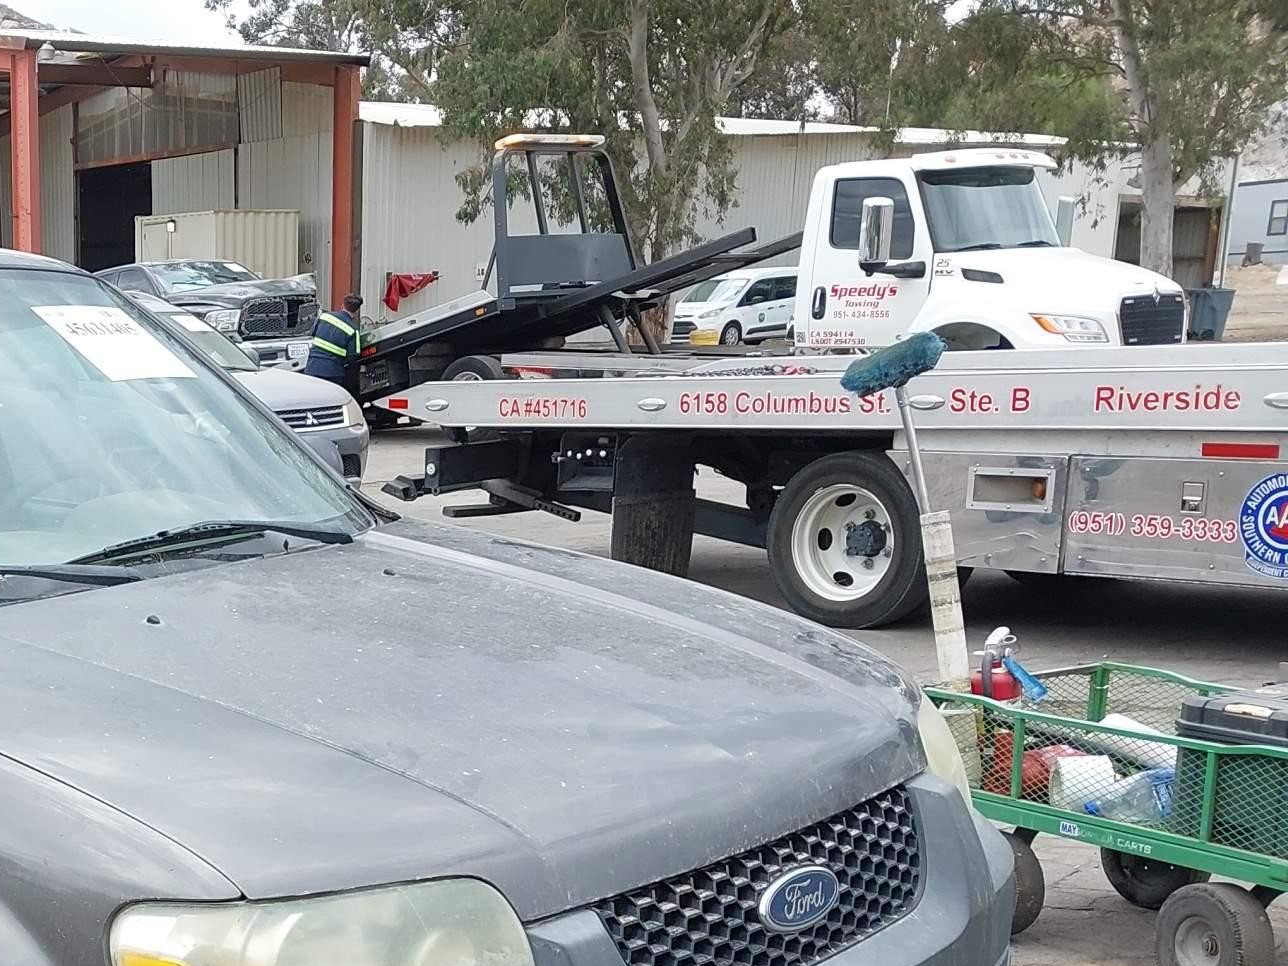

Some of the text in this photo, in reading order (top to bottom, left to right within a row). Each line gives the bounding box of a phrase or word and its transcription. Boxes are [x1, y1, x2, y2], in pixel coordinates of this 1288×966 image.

[830, 284, 898, 300] Speedy's
[845, 300, 880, 308] Towing
[679, 384, 1241, 413] 6158 Columbus St. Ste. B Riverside
[1246, 475, 1288, 511] AUTOMO
[1068, 511, 1238, 542] (951) 359-3333
[1242, 514, 1281, 565] SOUTHERN
[1061, 823, 1078, 836] MAY
[1116, 838, 1152, 854] CARTS
[784, 879, 825, 920] Ford
